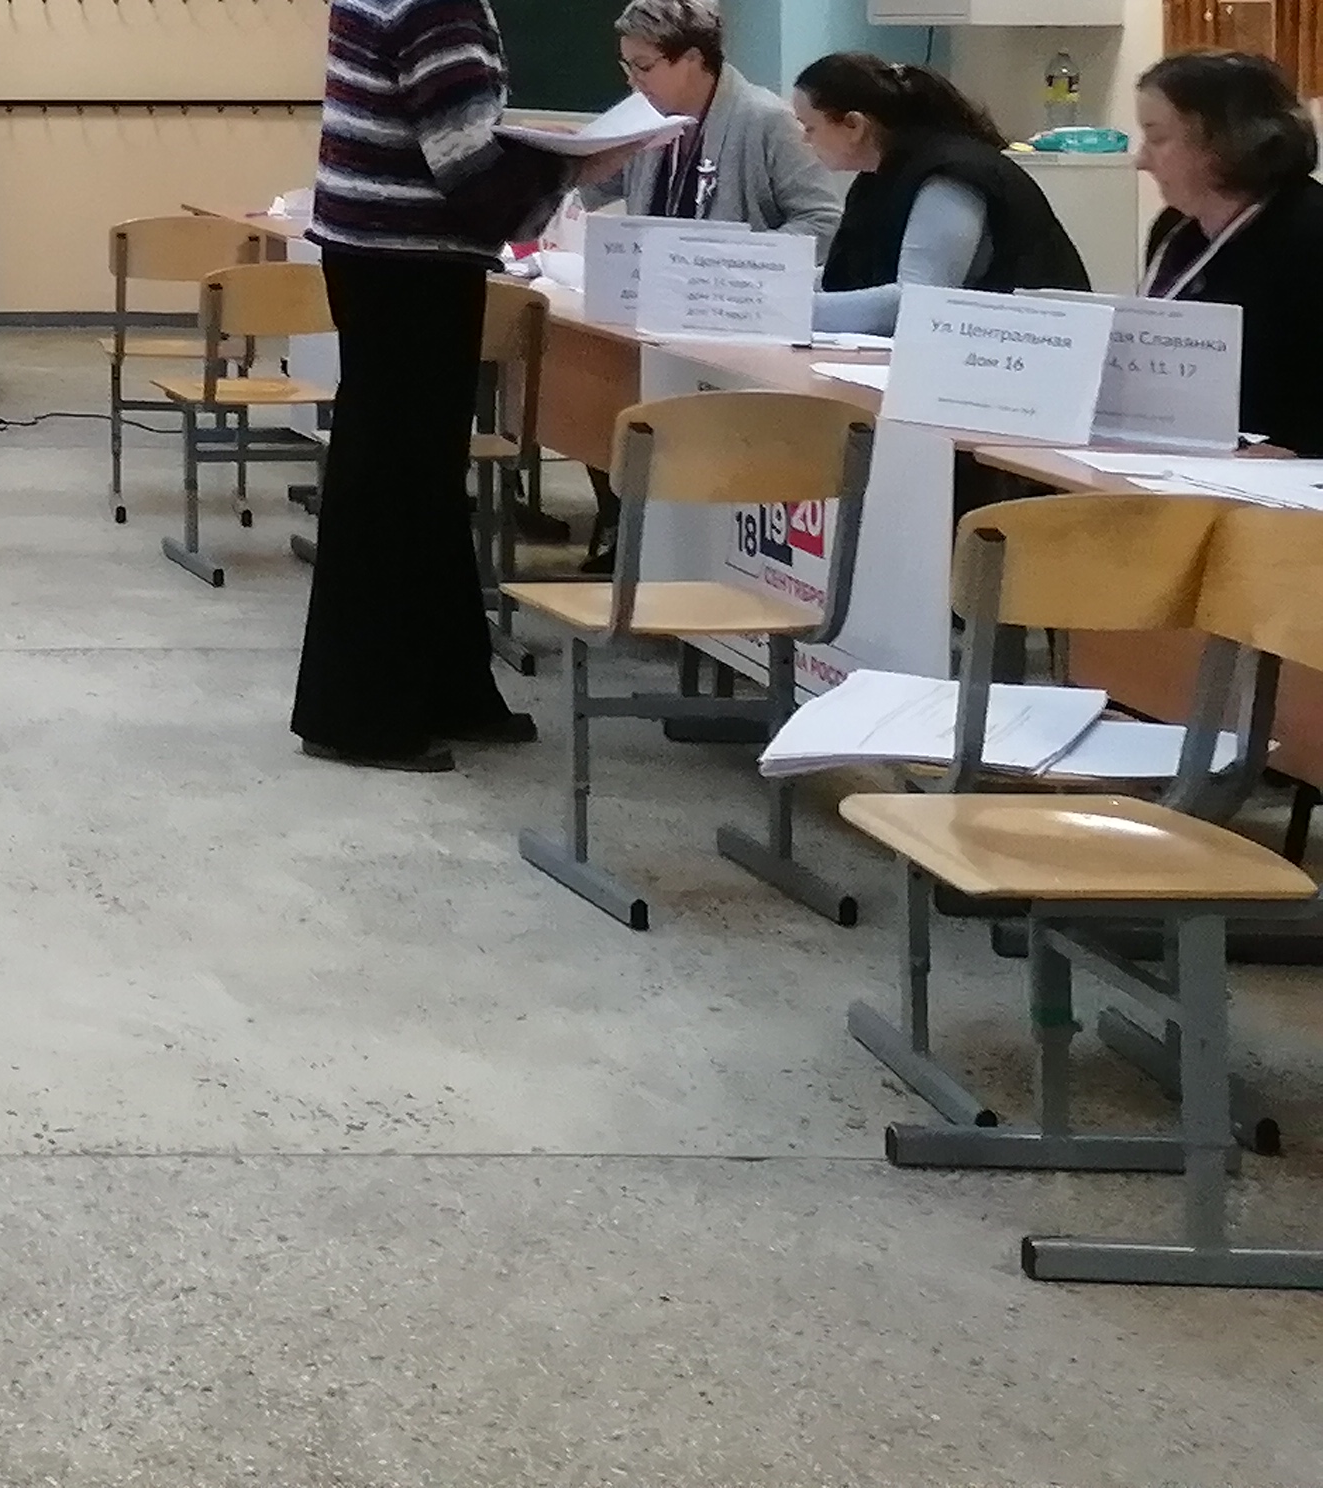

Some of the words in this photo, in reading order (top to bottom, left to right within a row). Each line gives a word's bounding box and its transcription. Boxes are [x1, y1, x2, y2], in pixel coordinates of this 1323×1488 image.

[959, 322, 1073, 349] Центральная
[1139, 331, 1228, 353] Славянка
[736, 510, 758, 558] 18
[764, 501, 788, 546] 19
